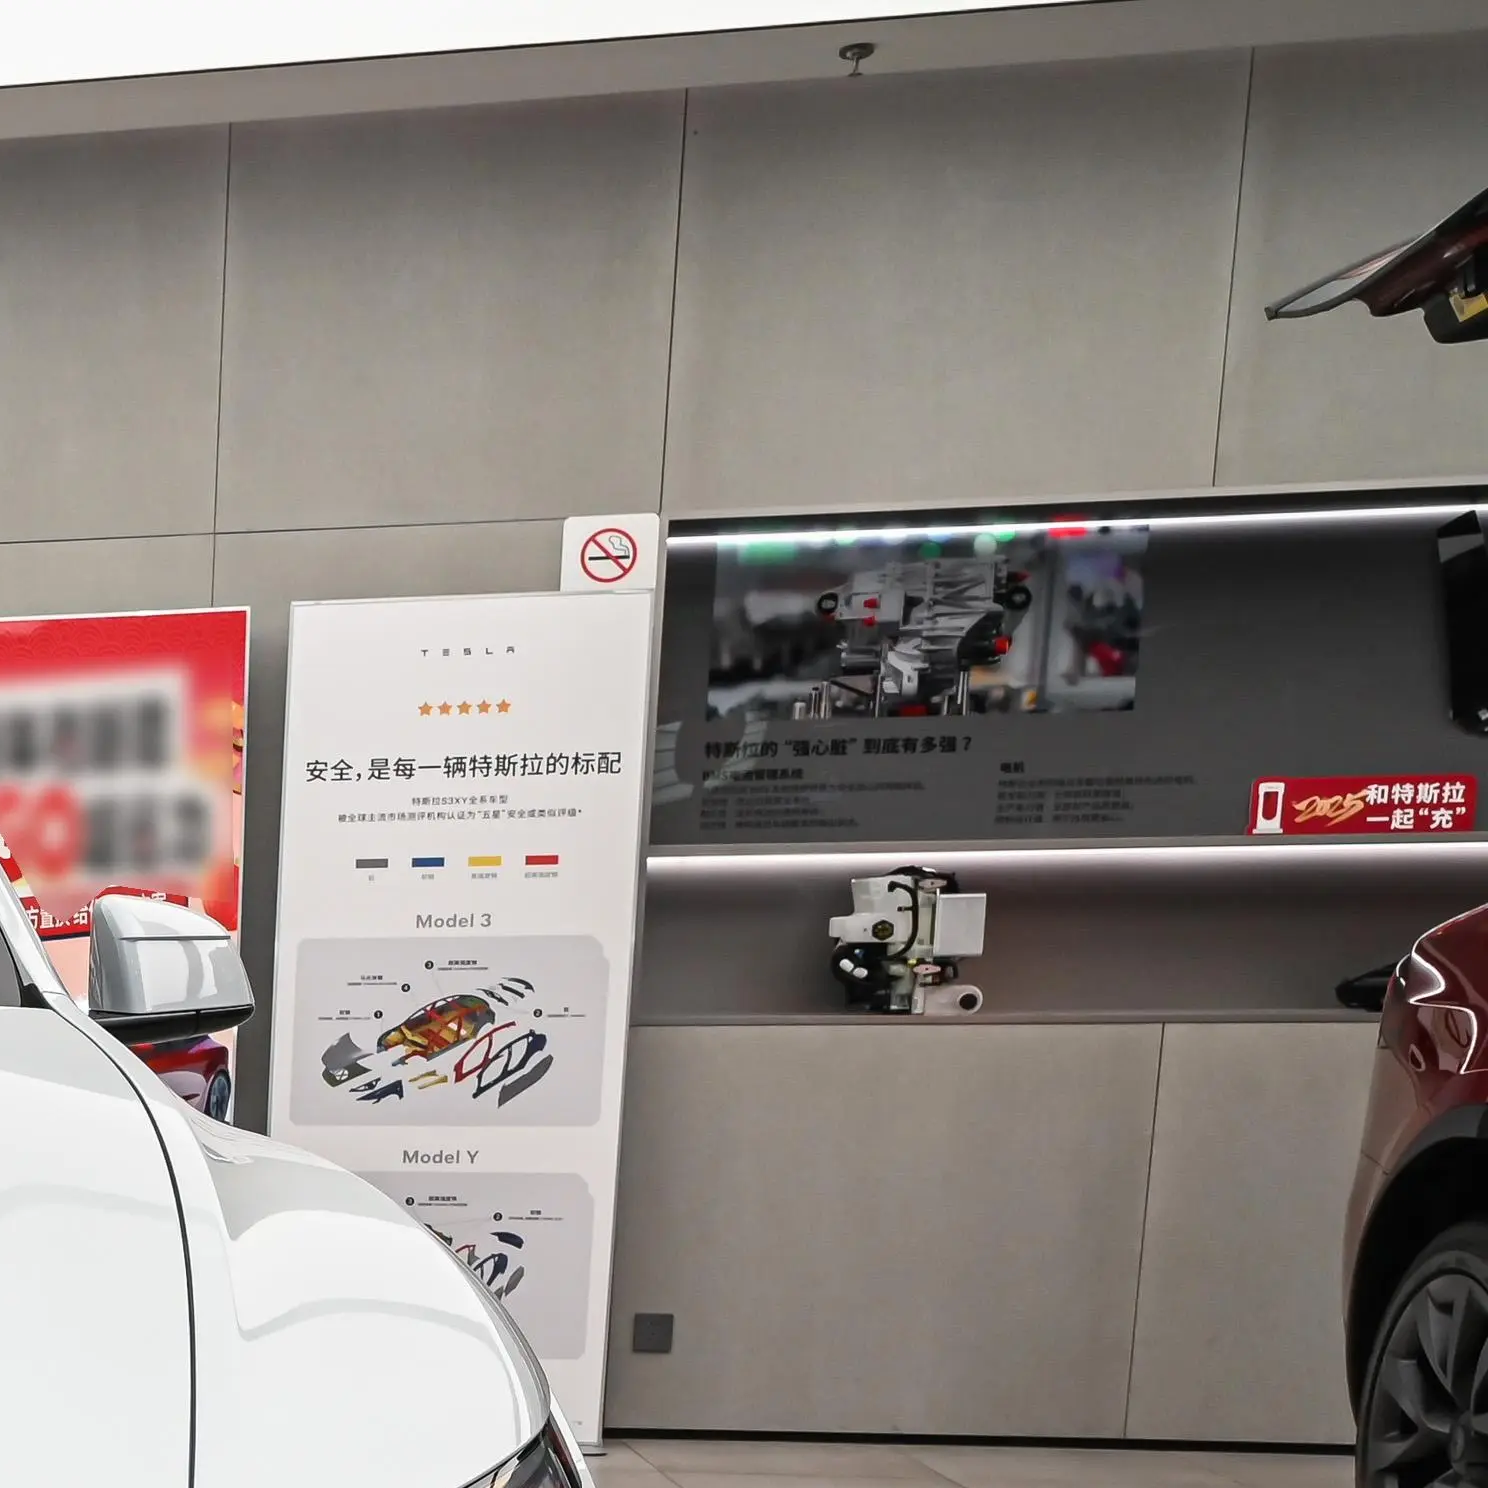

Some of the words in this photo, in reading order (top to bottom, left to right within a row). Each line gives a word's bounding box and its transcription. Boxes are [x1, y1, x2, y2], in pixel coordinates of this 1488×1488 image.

[420, 646, 516, 657] TESLA
[305, 751, 623, 783] 安全，是每一辆特斯拉的标配
[1292, 789, 1369, 828] 2025
[1366, 782, 1466, 805] 和特斯拉
[1366, 807, 1466, 831] 一起“充”
[415, 913, 475, 930] Model
[480, 913, 493, 929] 3
[402, 1149, 461, 1166] Model
[465, 1149, 480, 1165] Y
